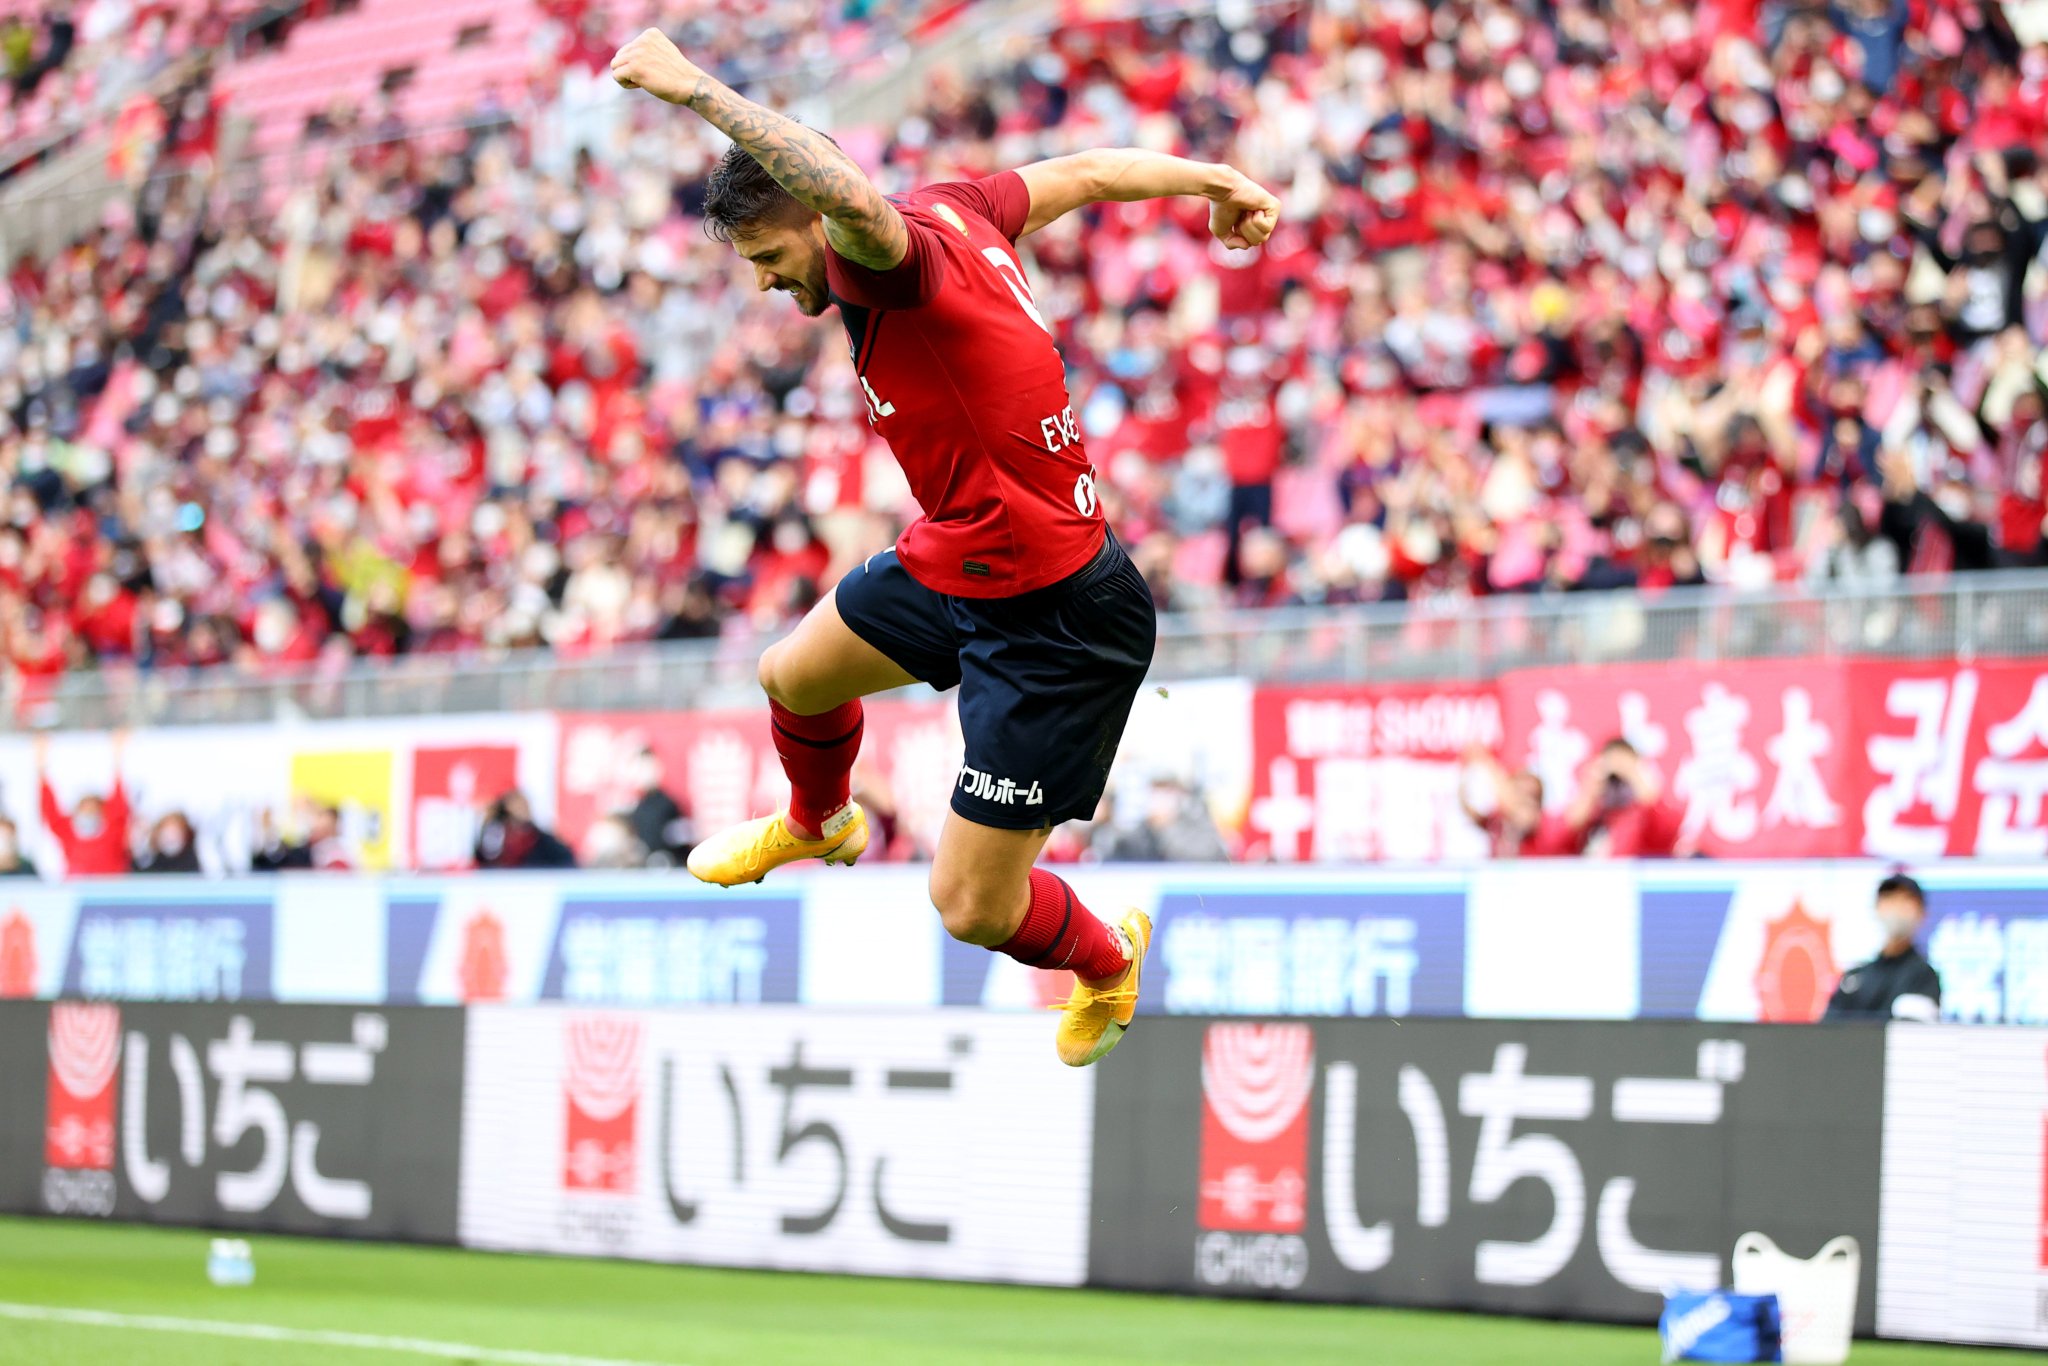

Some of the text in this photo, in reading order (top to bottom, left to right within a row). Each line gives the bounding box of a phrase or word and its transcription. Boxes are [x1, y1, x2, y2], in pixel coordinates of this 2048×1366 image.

[125, 1014, 389, 1219] いちご
[659, 1034, 973, 1243] いちご
[1323, 1039, 1746, 1294] いちご
